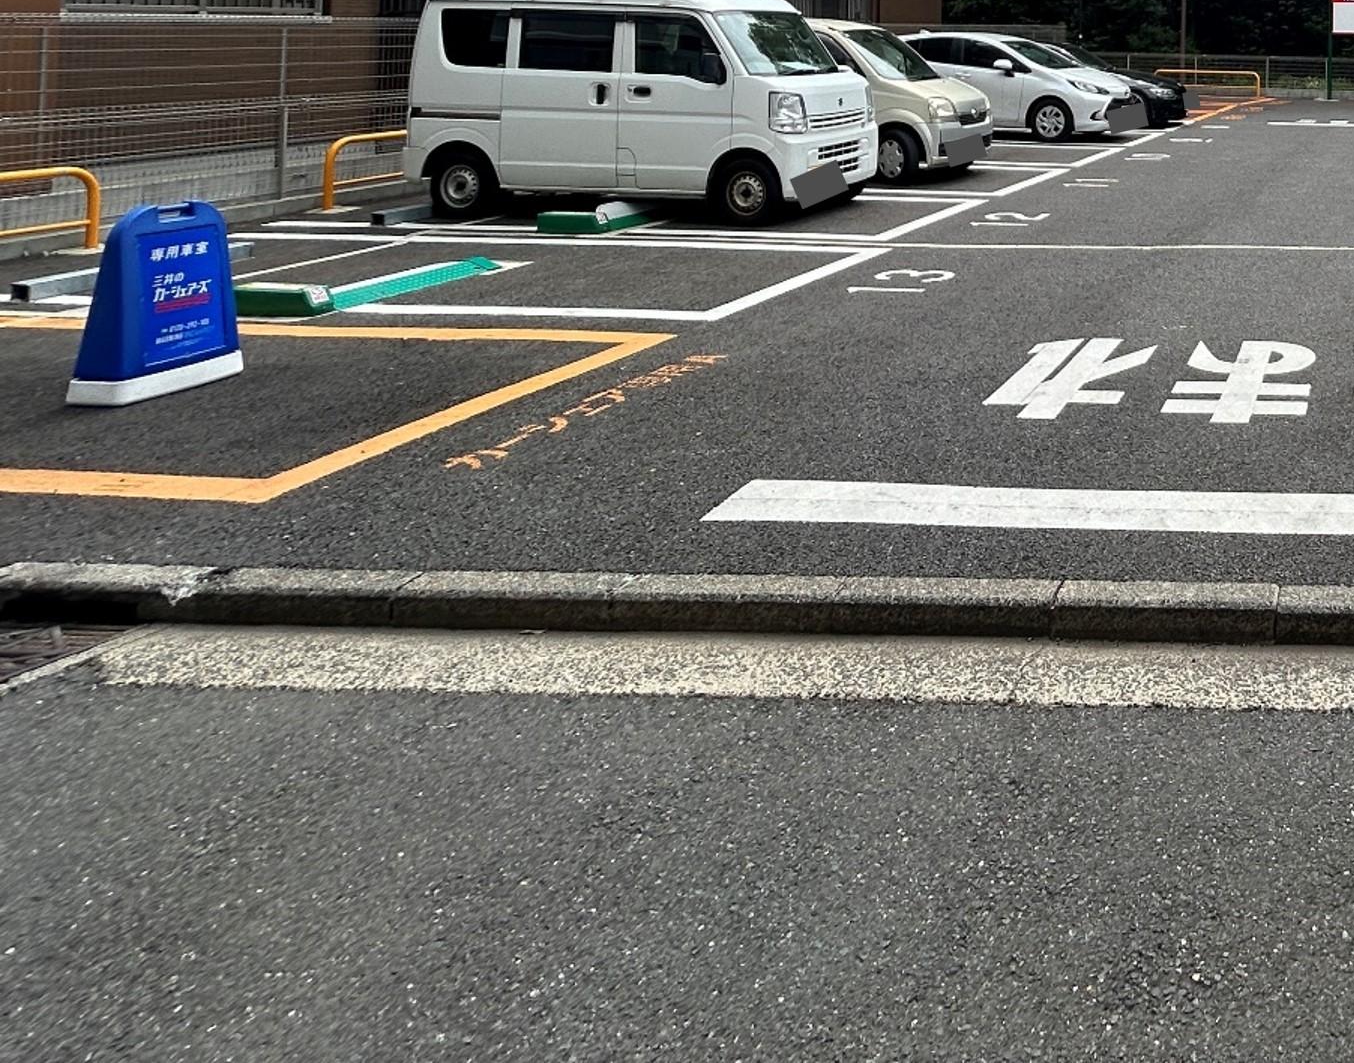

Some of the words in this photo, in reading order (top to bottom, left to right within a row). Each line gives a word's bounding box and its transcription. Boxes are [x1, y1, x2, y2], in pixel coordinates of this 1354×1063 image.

[969, 211, 1051, 227] 12
[150, 241, 209, 262] 専用車室
[152, 272, 185, 287] 三井の
[846, 268, 956, 294] 13
[152, 279, 213, 303] カーシェアーズ
